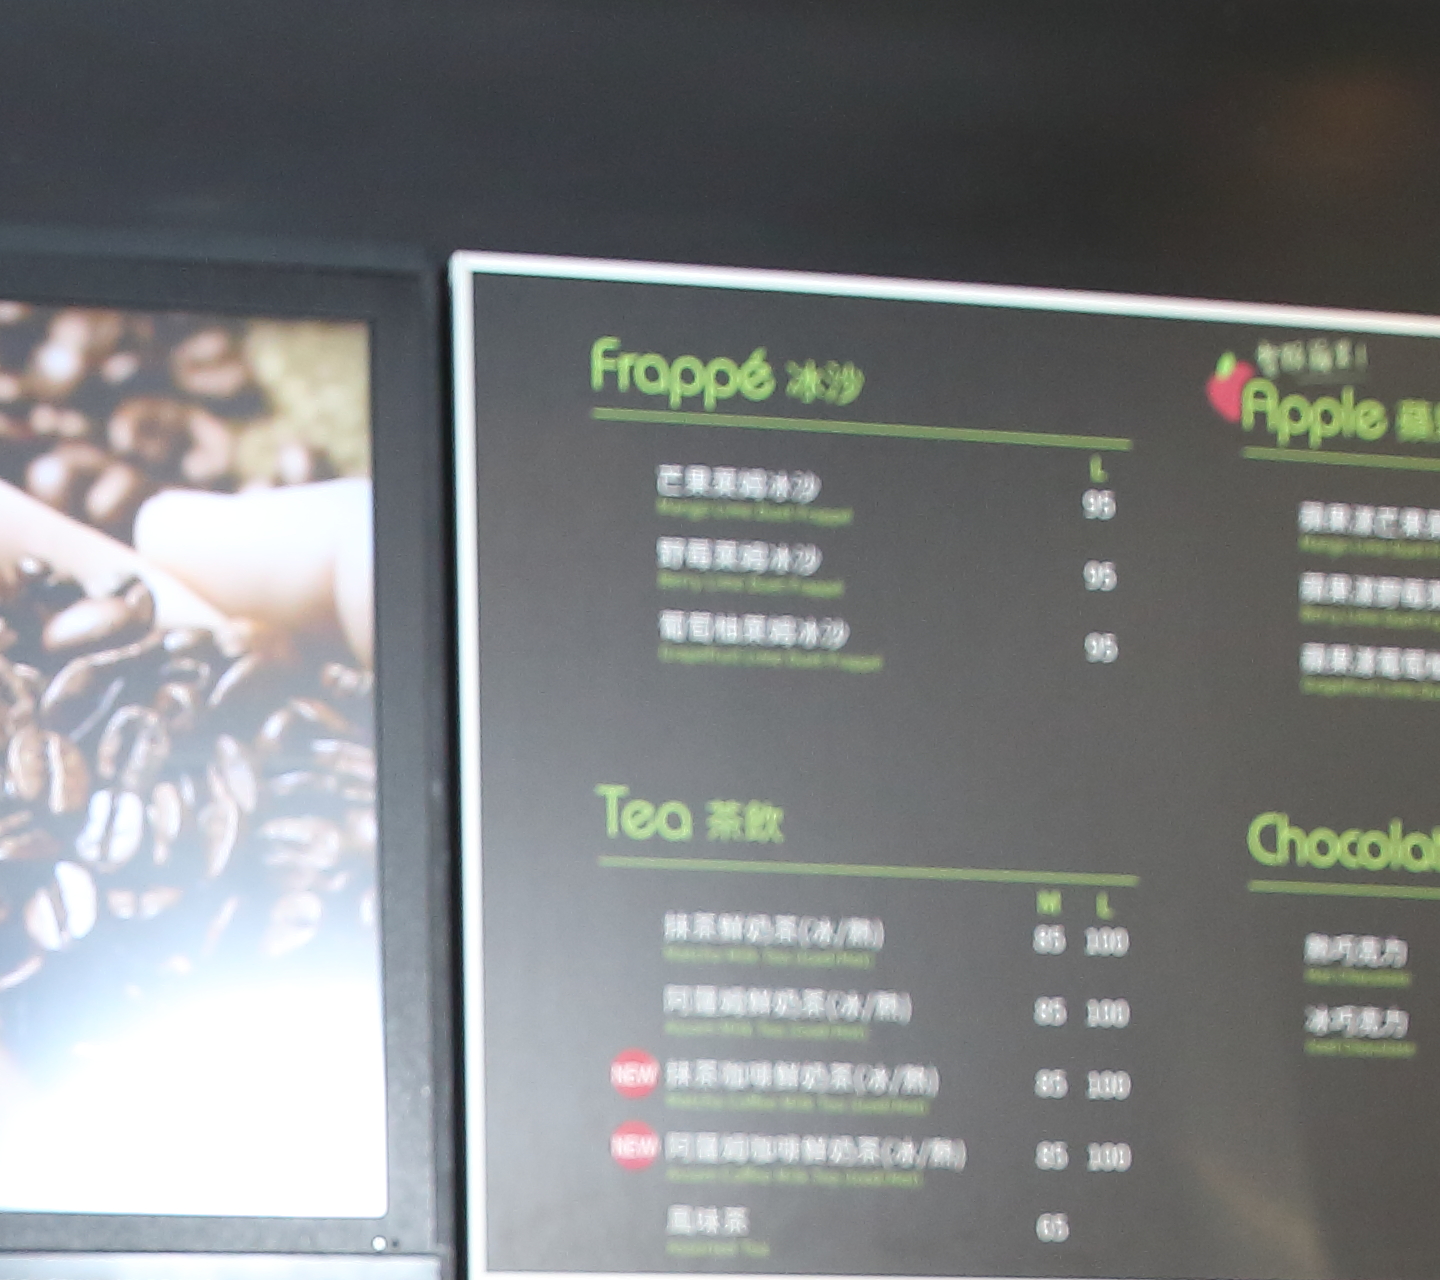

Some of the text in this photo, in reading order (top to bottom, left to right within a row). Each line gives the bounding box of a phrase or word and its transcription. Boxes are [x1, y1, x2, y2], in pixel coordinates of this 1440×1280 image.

[591, 336, 865, 411] Frappé 冰沙
[1240, 377, 1389, 450] Apple
[593, 783, 785, 845] Tea 茶飲
[611, 1064, 661, 1087] NEW
[611, 1135, 661, 1161] NEW
